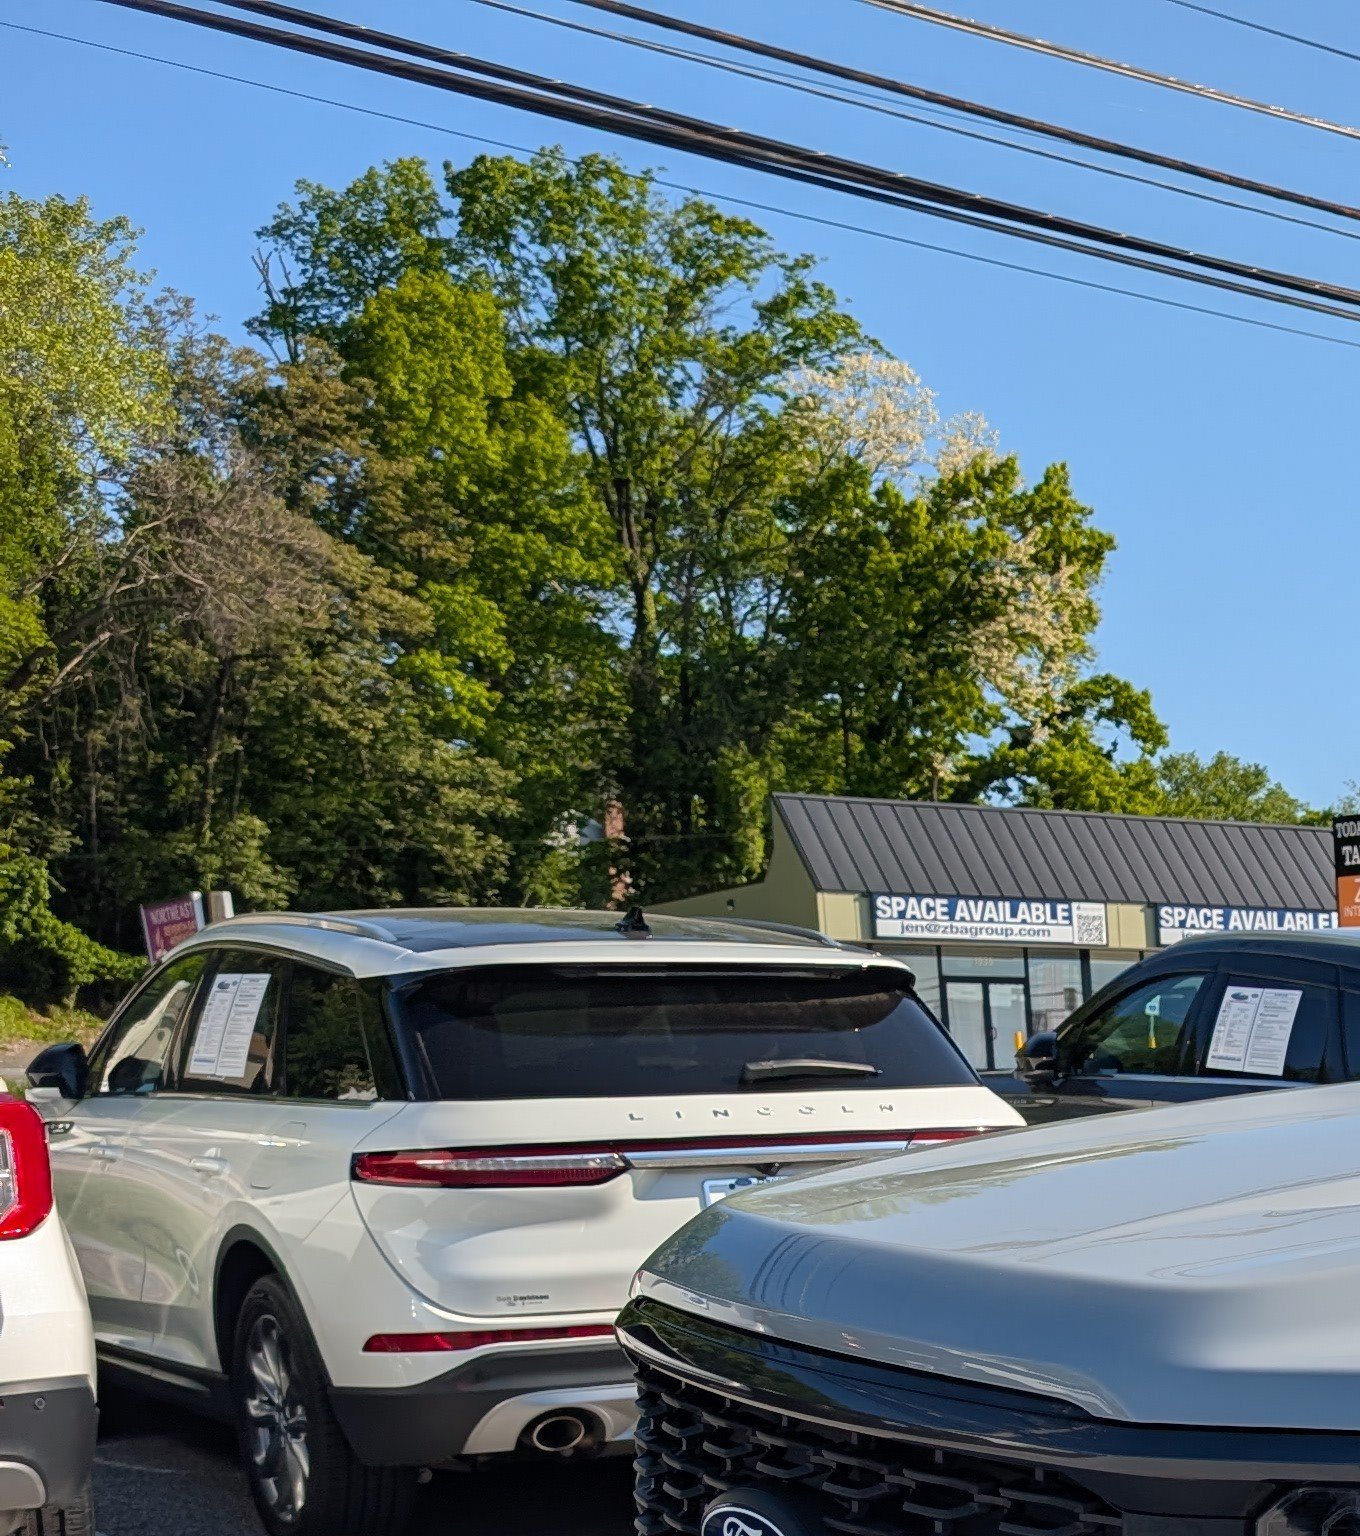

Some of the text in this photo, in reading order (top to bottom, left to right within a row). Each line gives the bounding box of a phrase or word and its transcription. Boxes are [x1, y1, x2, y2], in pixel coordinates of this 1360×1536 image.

[876, 896, 1070, 924] SPACE AVAILABLE
[1160, 906, 1225, 929] SPACE
[901, 921, 1051, 938] jen@zbagroup.com
[629, 1103, 894, 1122] LINCOLN
